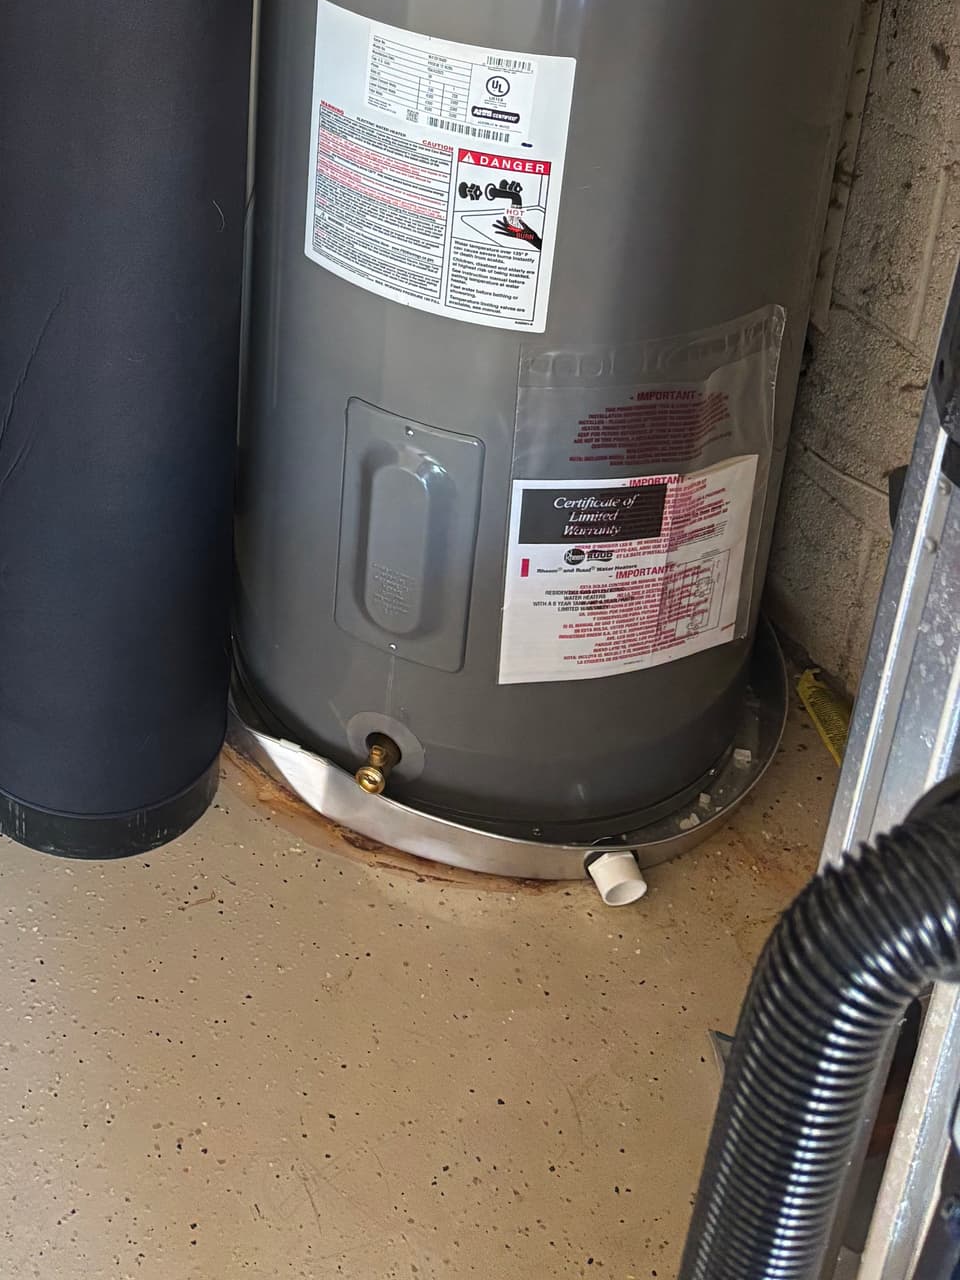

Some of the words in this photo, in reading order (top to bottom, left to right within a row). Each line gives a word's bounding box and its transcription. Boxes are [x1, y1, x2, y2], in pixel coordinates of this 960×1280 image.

[422, 139, 454, 151] CAUTION
[480, 155, 545, 173] DANGER
[636, 391, 697, 401] IMPORTANT
[629, 475, 685, 488] IMPORTANT
[553, 496, 620, 511] Certificate
[622, 493, 640, 509] of
[569, 508, 620, 522] Limited
[563, 524, 621, 537] Warranty
[615, 563, 676, 580] IMPORTANTE
